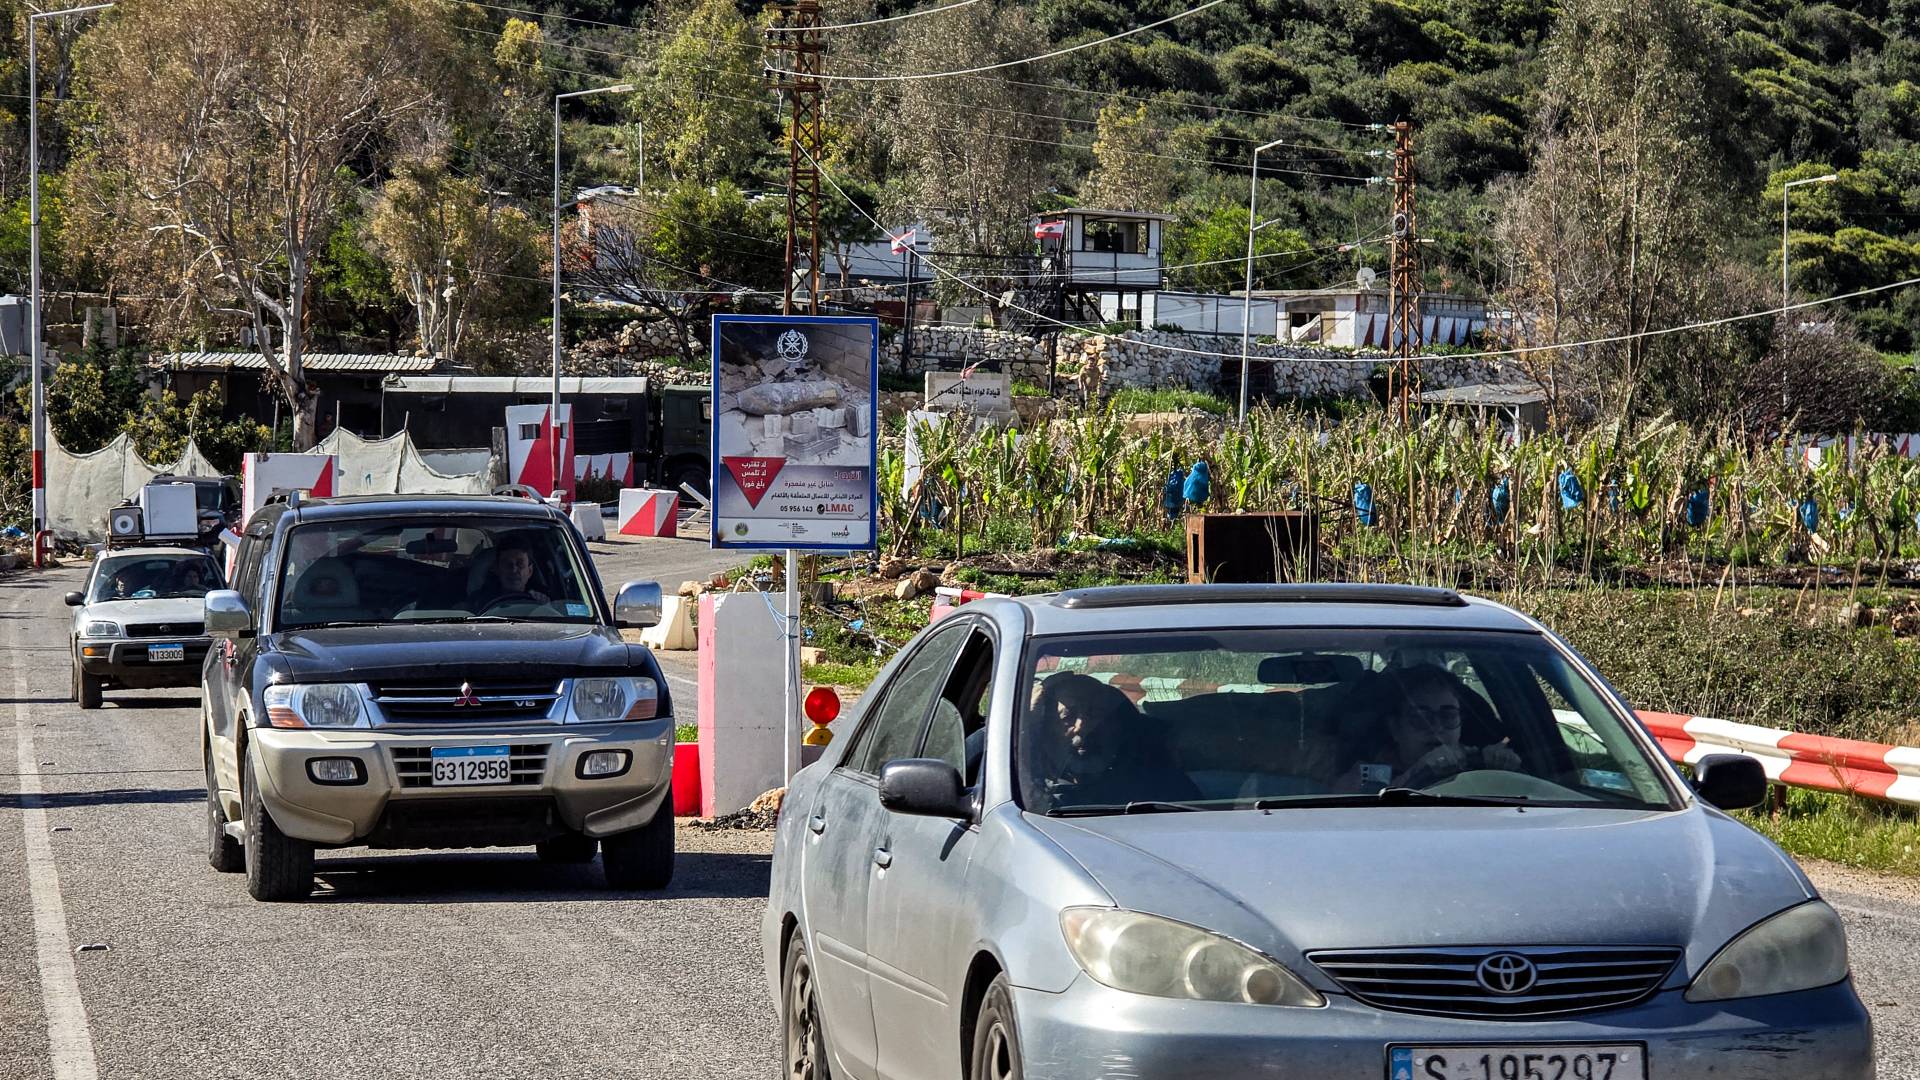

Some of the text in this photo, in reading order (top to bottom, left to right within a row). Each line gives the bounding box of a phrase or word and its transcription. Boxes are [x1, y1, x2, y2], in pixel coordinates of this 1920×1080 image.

[986, 387, 1000, 399] قيادة
[741, 461, 760, 469] تقترب
[741, 469, 760, 478] تلمس
[785, 480, 806, 489] منفجرة
[825, 503, 854, 512] LMAC
[435, 760, 508, 781] G312958
[1424, 1053, 1617, 1080] S 195297
